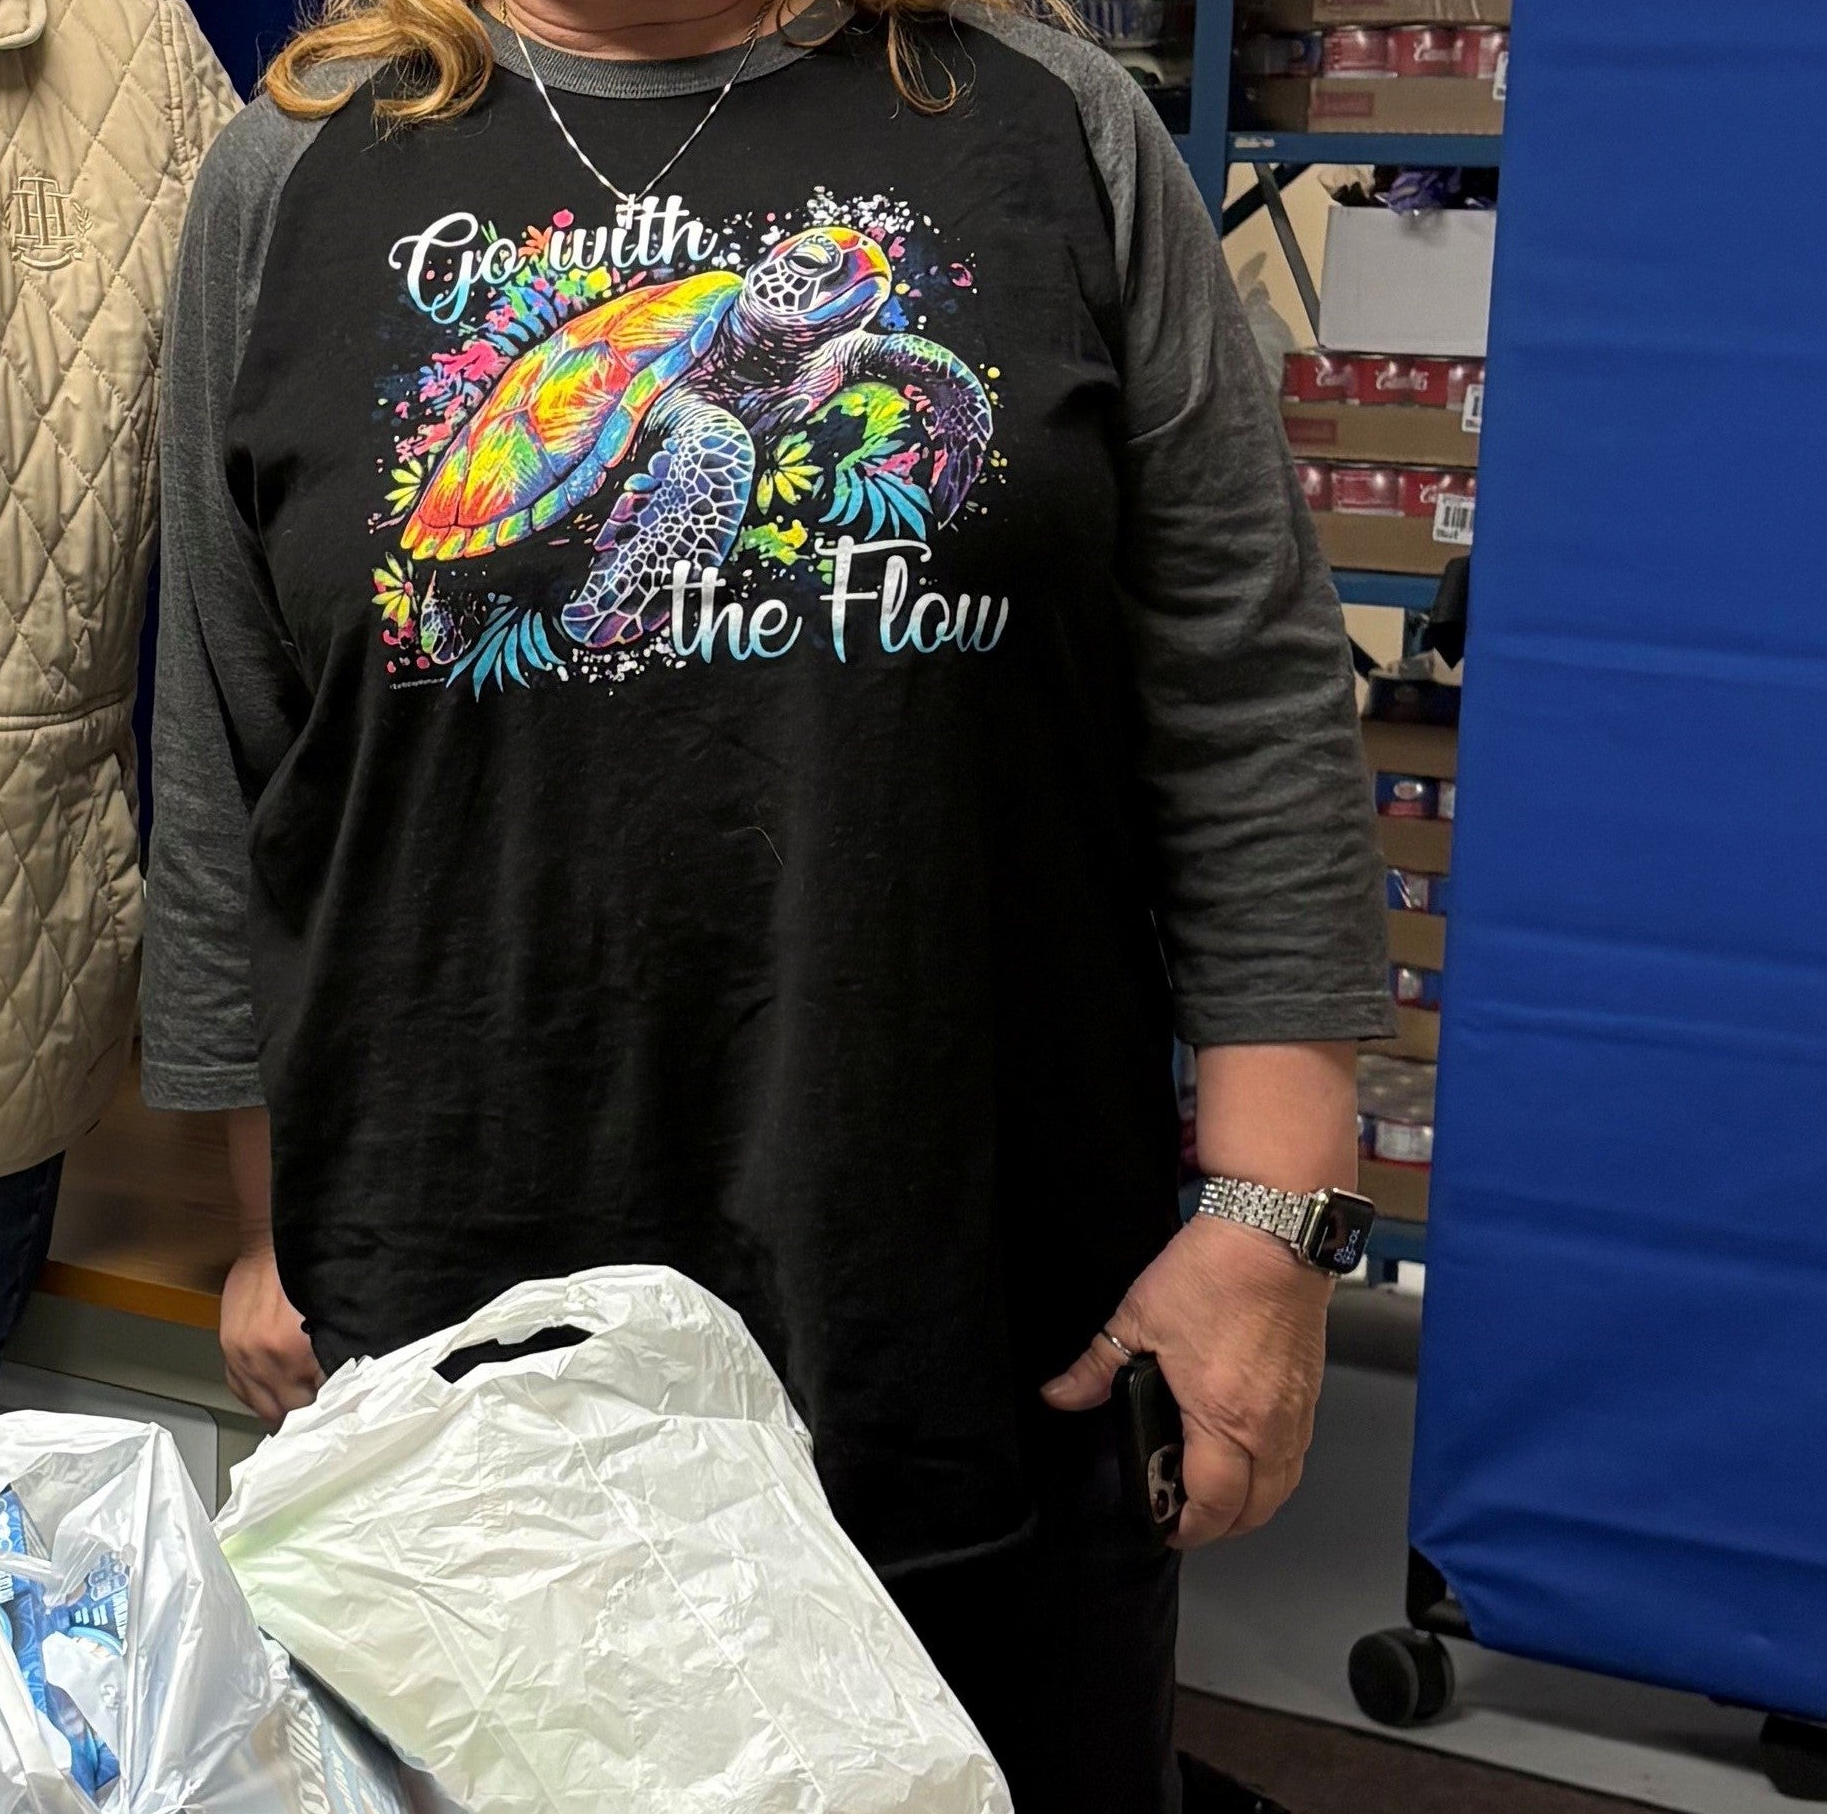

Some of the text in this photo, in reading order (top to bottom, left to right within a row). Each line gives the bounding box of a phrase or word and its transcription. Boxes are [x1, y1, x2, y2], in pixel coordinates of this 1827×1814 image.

[388, 195, 720, 325] Go with
[659, 535, 1008, 665] the Flow
